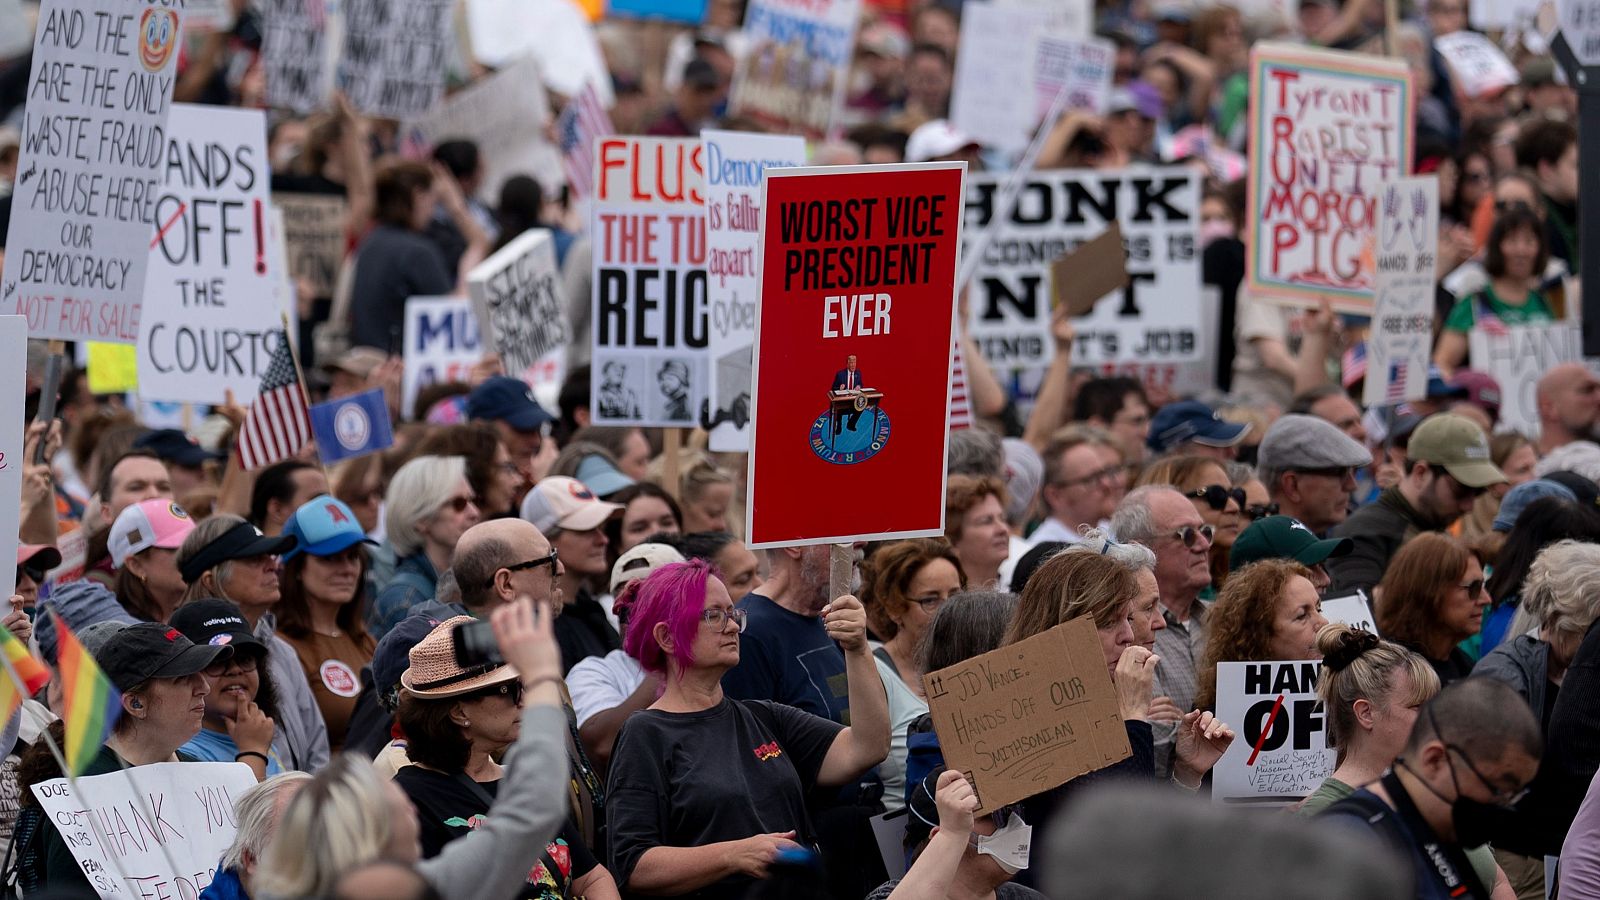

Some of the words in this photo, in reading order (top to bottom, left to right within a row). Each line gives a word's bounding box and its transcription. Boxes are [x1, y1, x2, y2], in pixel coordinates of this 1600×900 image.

[41, 8, 84, 49] AND
[94, 11, 134, 56] THE
[31, 62, 75, 103] ARE
[81, 66, 119, 109] THE
[124, 72, 171, 115] ONLY
[26, 112, 90, 164] WASTE,
[98, 120, 164, 169] FRAUD
[164, 138, 255, 193] ANDS
[31, 168, 103, 217] ABUSE
[105, 177, 155, 225] HERE
[709, 196, 722, 232] is
[780, 198, 878, 244] WORST
[886, 195, 946, 238] VICE
[60, 220, 92, 250] OUR
[600, 214, 659, 264] THE
[1272, 223, 1361, 280] PIG
[20, 249, 131, 291] DEMOCRACY
[709, 246, 756, 289] apart
[784, 242, 937, 292] PRESIDENT
[176, 279, 227, 308] THE
[822, 293, 892, 339] EVER
[982, 272, 1156, 321] NT
[16, 296, 55, 331] NOT
[59, 298, 92, 334] FOR
[98, 302, 142, 341] SALE
[148, 323, 279, 376] COURTS
[974, 335, 1042, 360] ING
[1139, 331, 1196, 354] JOB
[203, 618, 226, 627] voting
[947, 668, 982, 702] JD
[951, 709, 1007, 746] HANDS
[1011, 696, 1036, 720] OFF
[1050, 676, 1087, 706] OUR
[1243, 699, 1337, 752] OF
[974, 720, 1075, 772] SMITHSONIAN
[1259, 753, 1289, 767] Social
[1292, 750, 1328, 767] Security
[40, 783, 70, 798] DOE
[1248, 769, 1310, 787] VETERAN
[1257, 783, 1312, 793] Education
[66, 831, 92, 848] NPS
[74, 792, 184, 861] THANK
[195, 785, 238, 834] YOU
[123, 868, 217, 900] FEDE
[1424, 842, 1459, 888] SONY
